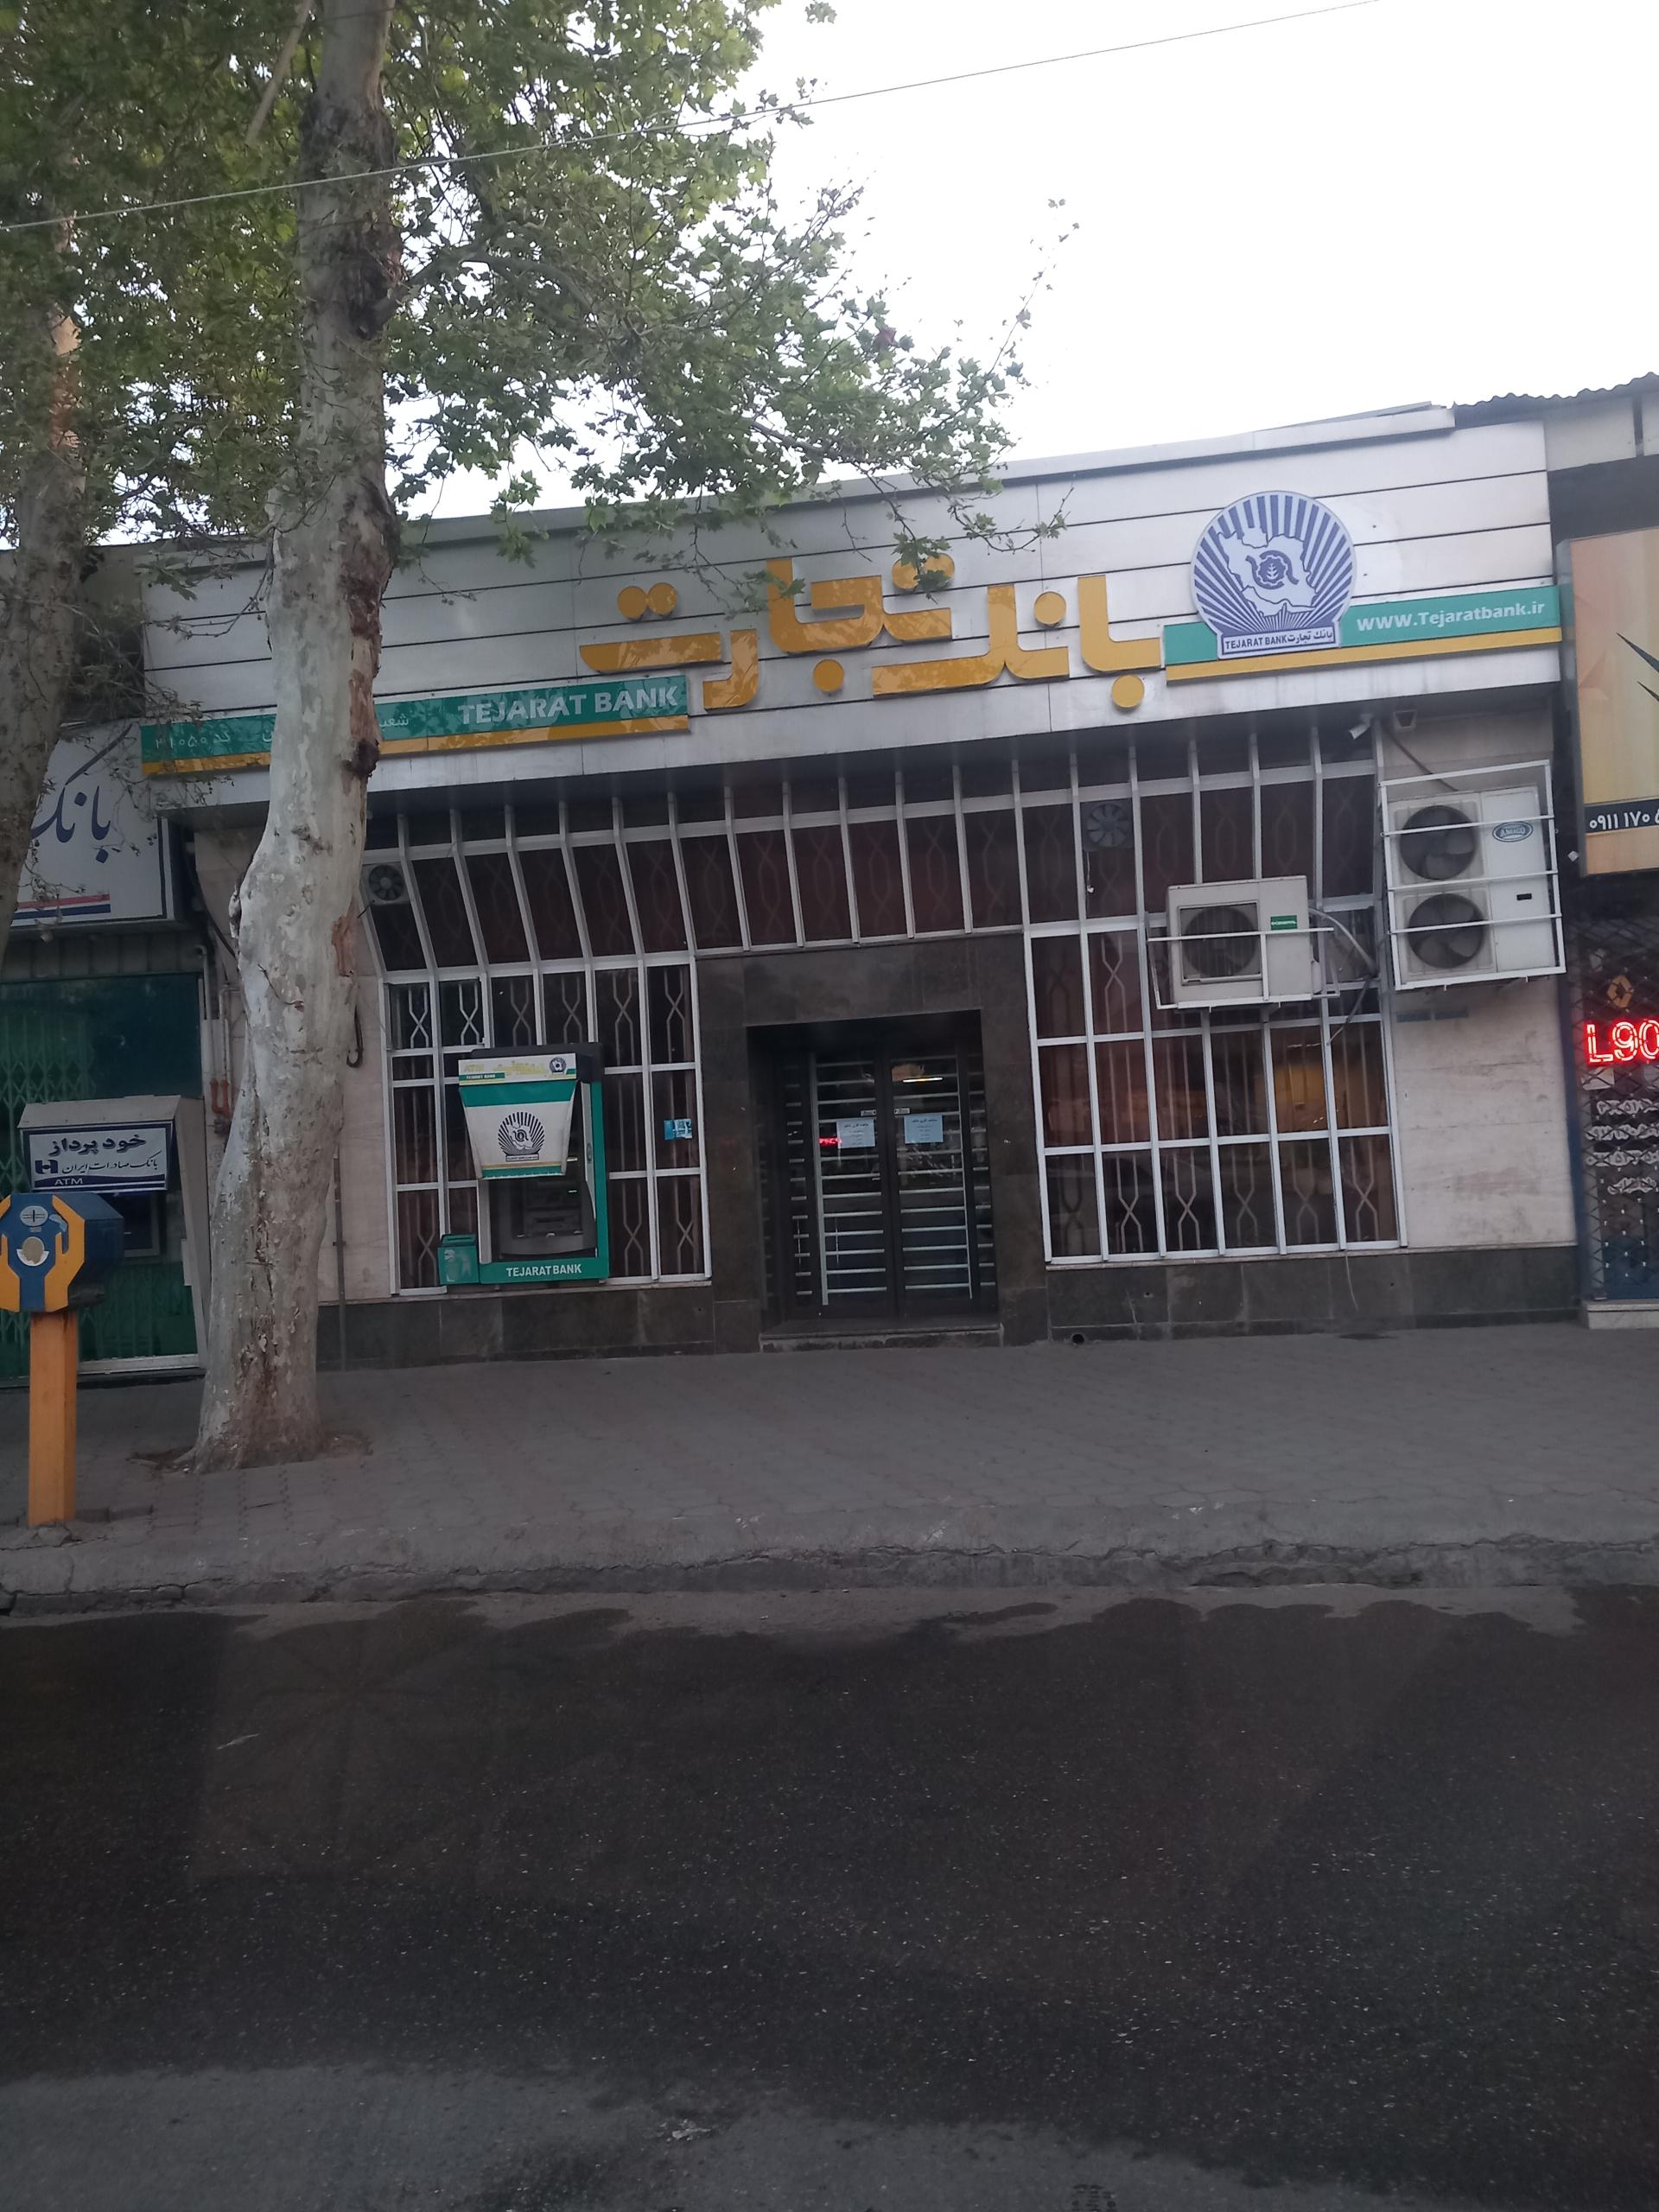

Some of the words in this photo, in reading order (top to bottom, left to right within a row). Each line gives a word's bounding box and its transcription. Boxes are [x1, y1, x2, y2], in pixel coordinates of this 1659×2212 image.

[580, 553, 953, 711] تجارت
[1225, 637, 1262, 650] TEJARAT
[1265, 634, 1287, 645] BANK
[458, 694, 587, 725] TEJARAT
[594, 685, 678, 713] BANK
[378, 713, 410, 732] شعب
[1589, 813, 1619, 830] ۰۹۱۱
[1586, 1020, 1659, 1063] L90
[48, 1137, 99, 1157] پرداز
[102, 1134, 147, 1153] خود
[62, 1163, 88, 1174] ایران
[505, 1266, 551, 1277] TEJARAT
[553, 1264, 582, 1274] BANK
